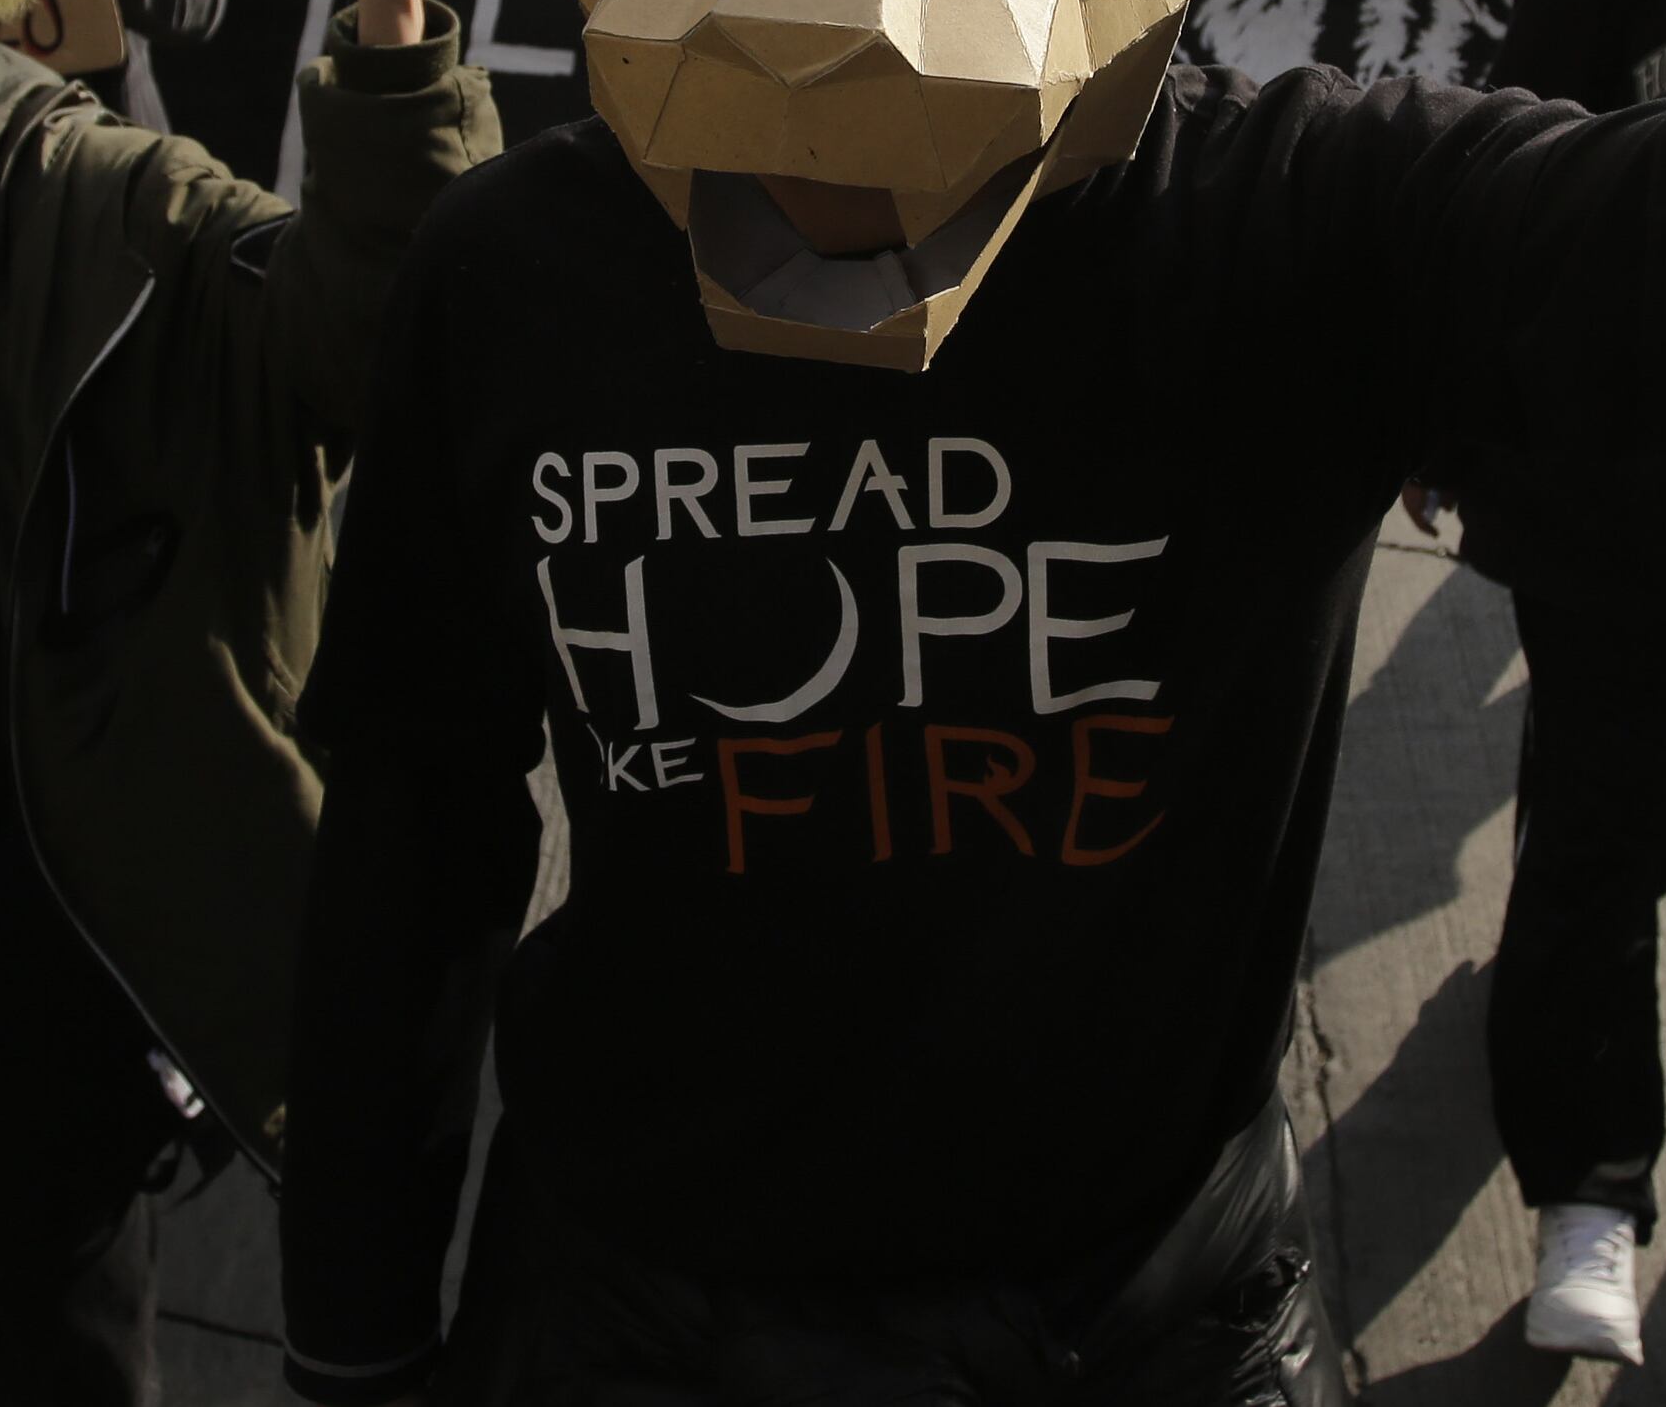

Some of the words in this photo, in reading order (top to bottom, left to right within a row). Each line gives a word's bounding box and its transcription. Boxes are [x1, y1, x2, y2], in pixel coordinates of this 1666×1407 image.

[531, 436, 1012, 544] SPREAD
[536, 535, 1170, 731] HOPE
[716, 714, 1176, 875] FIRE
